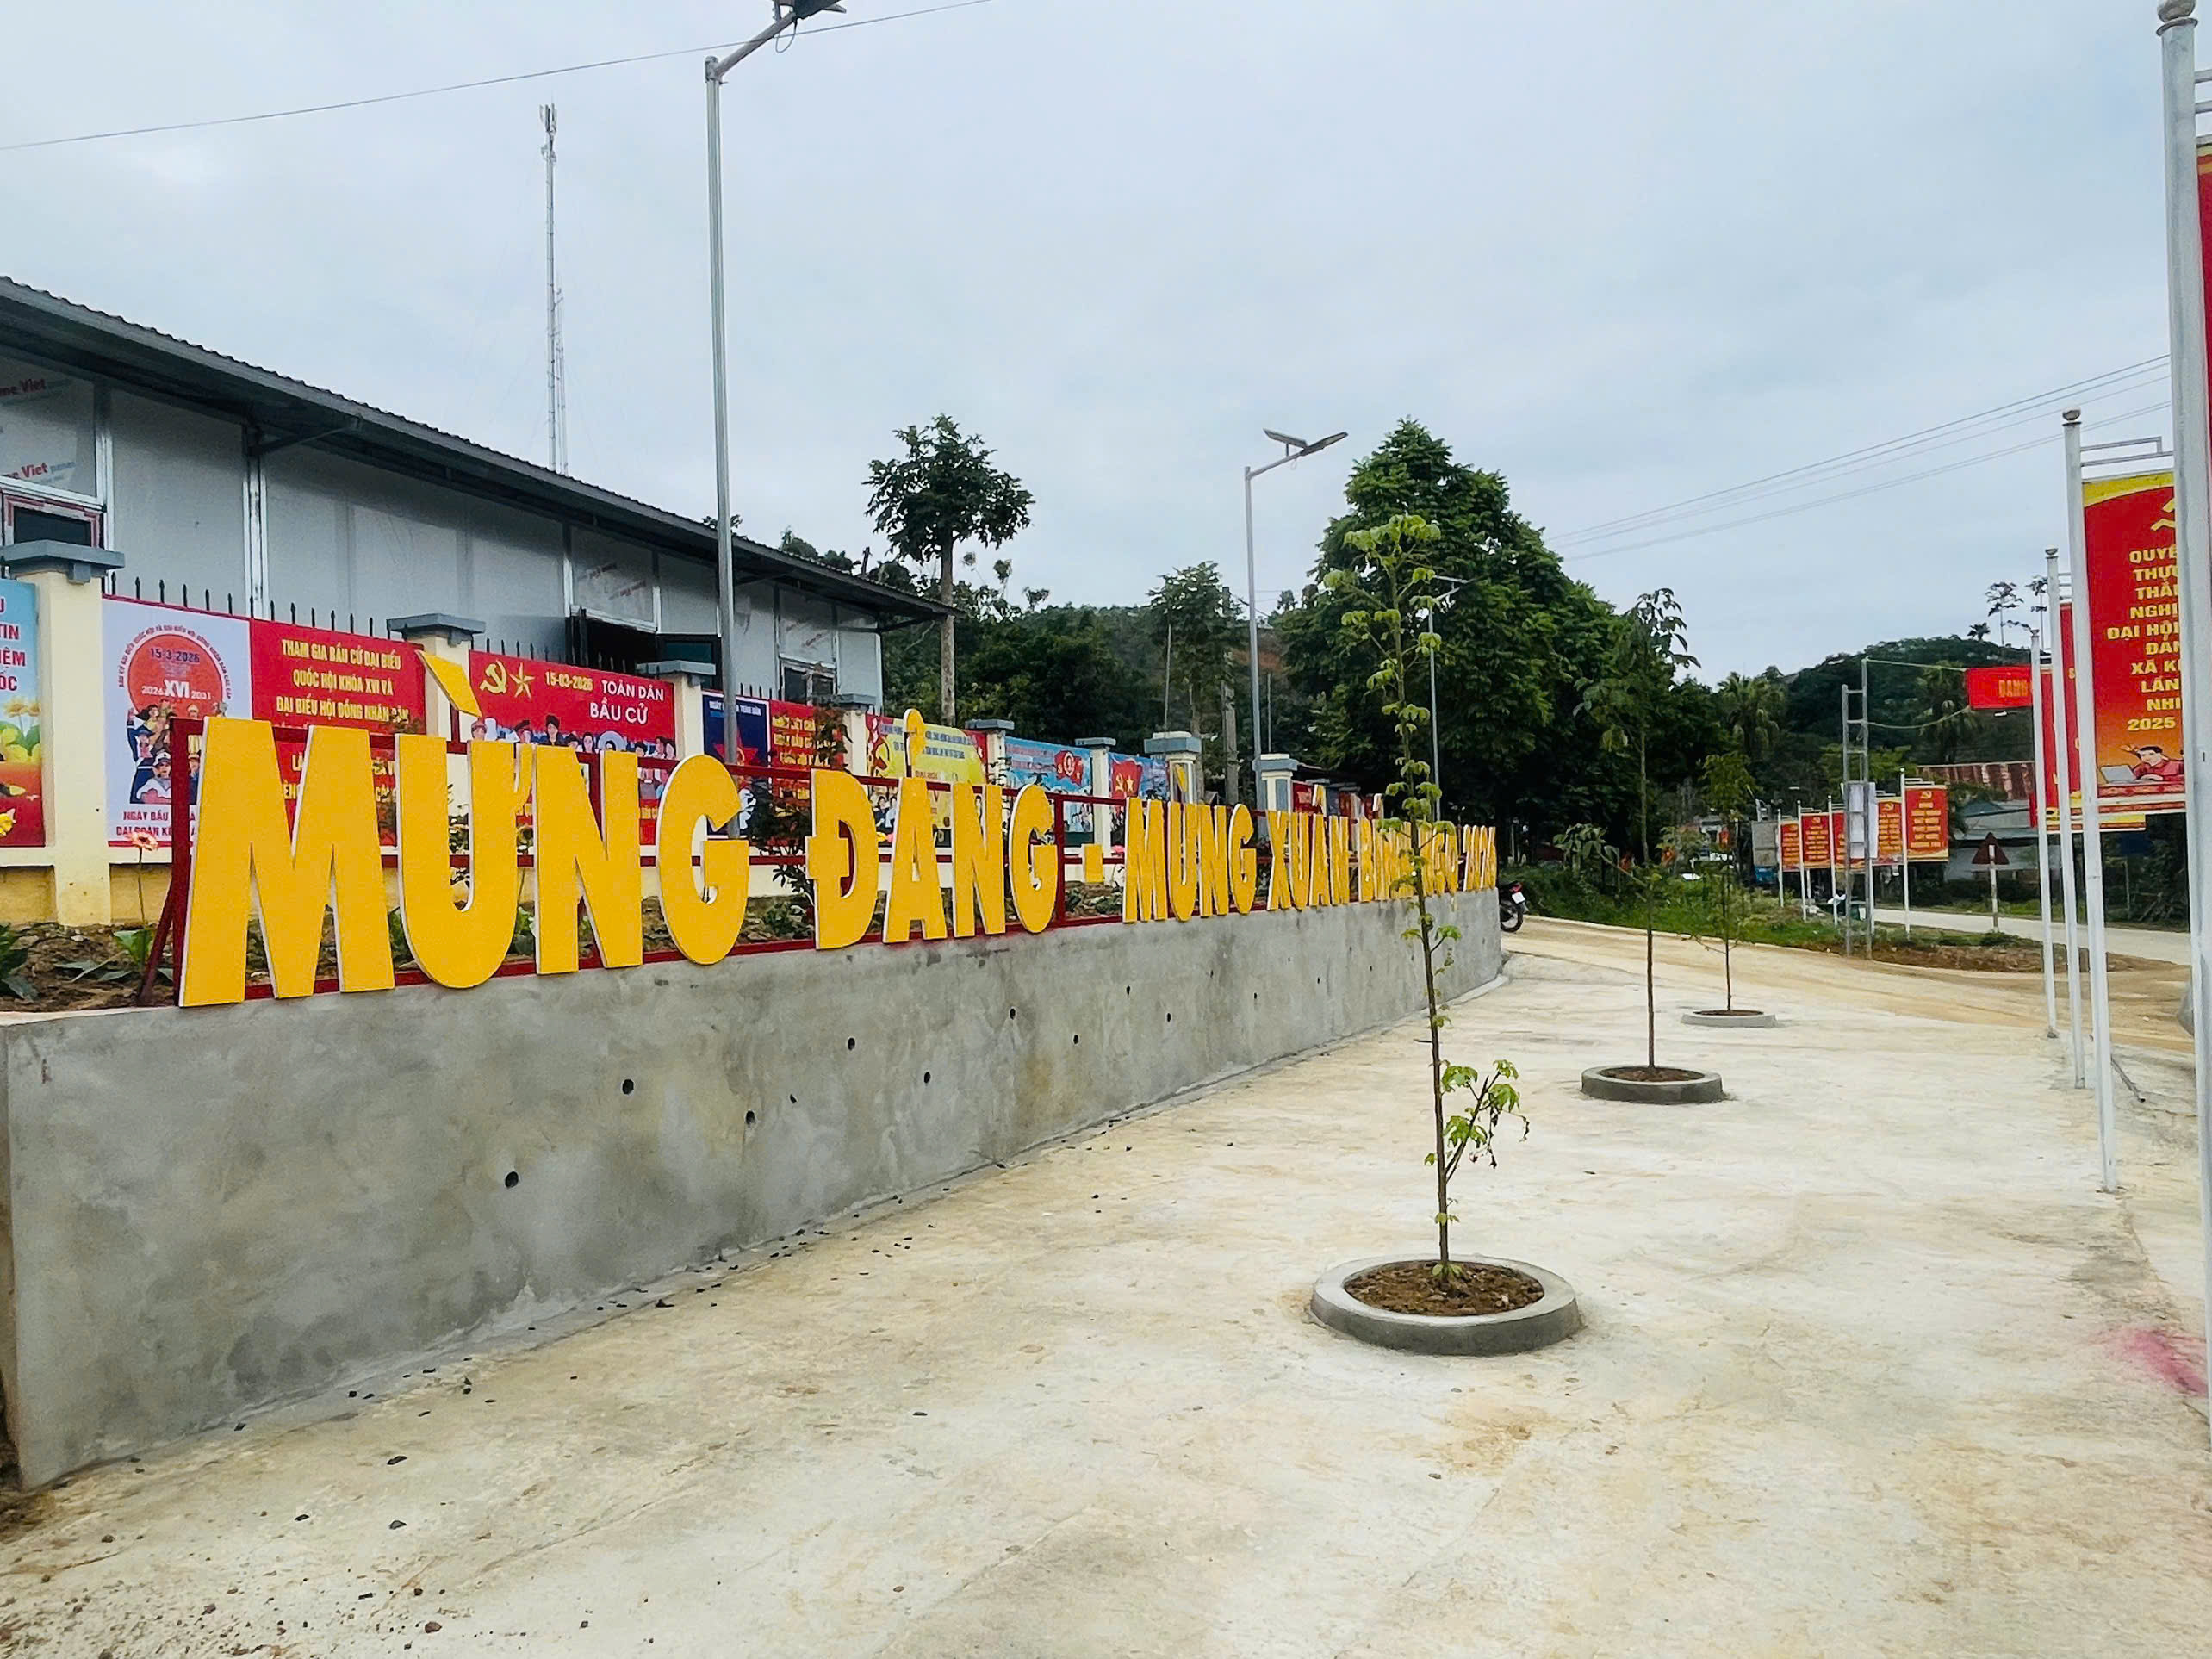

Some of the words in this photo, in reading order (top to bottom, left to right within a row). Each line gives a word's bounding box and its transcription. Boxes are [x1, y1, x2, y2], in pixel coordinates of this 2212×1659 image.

[21, 463, 47, 478] Viet
[2129, 544, 2177, 563] QUYẾ
[282, 639, 309, 658] THAM
[311, 643, 327, 661] GIA
[164, 680, 190, 699] XVI
[293, 666, 320, 688] QUỐC
[365, 678, 379, 693] XVI
[381, 677, 393, 695] VÀ
[601, 679, 635, 697] TOÀN
[638, 684, 664, 701] DÂN
[590, 696, 621, 721] BẦU
[625, 703, 649, 724] CỬ
[2147, 697, 2180, 711] NHI
[2128, 717, 2176, 730] 2025
[179, 649, 749, 1007] MỪNG
[805, 708, 1058, 950] ĐẢNG
[1122, 764, 1257, 924] MỪNG
[1266, 784, 1350, 911] XUÂN
